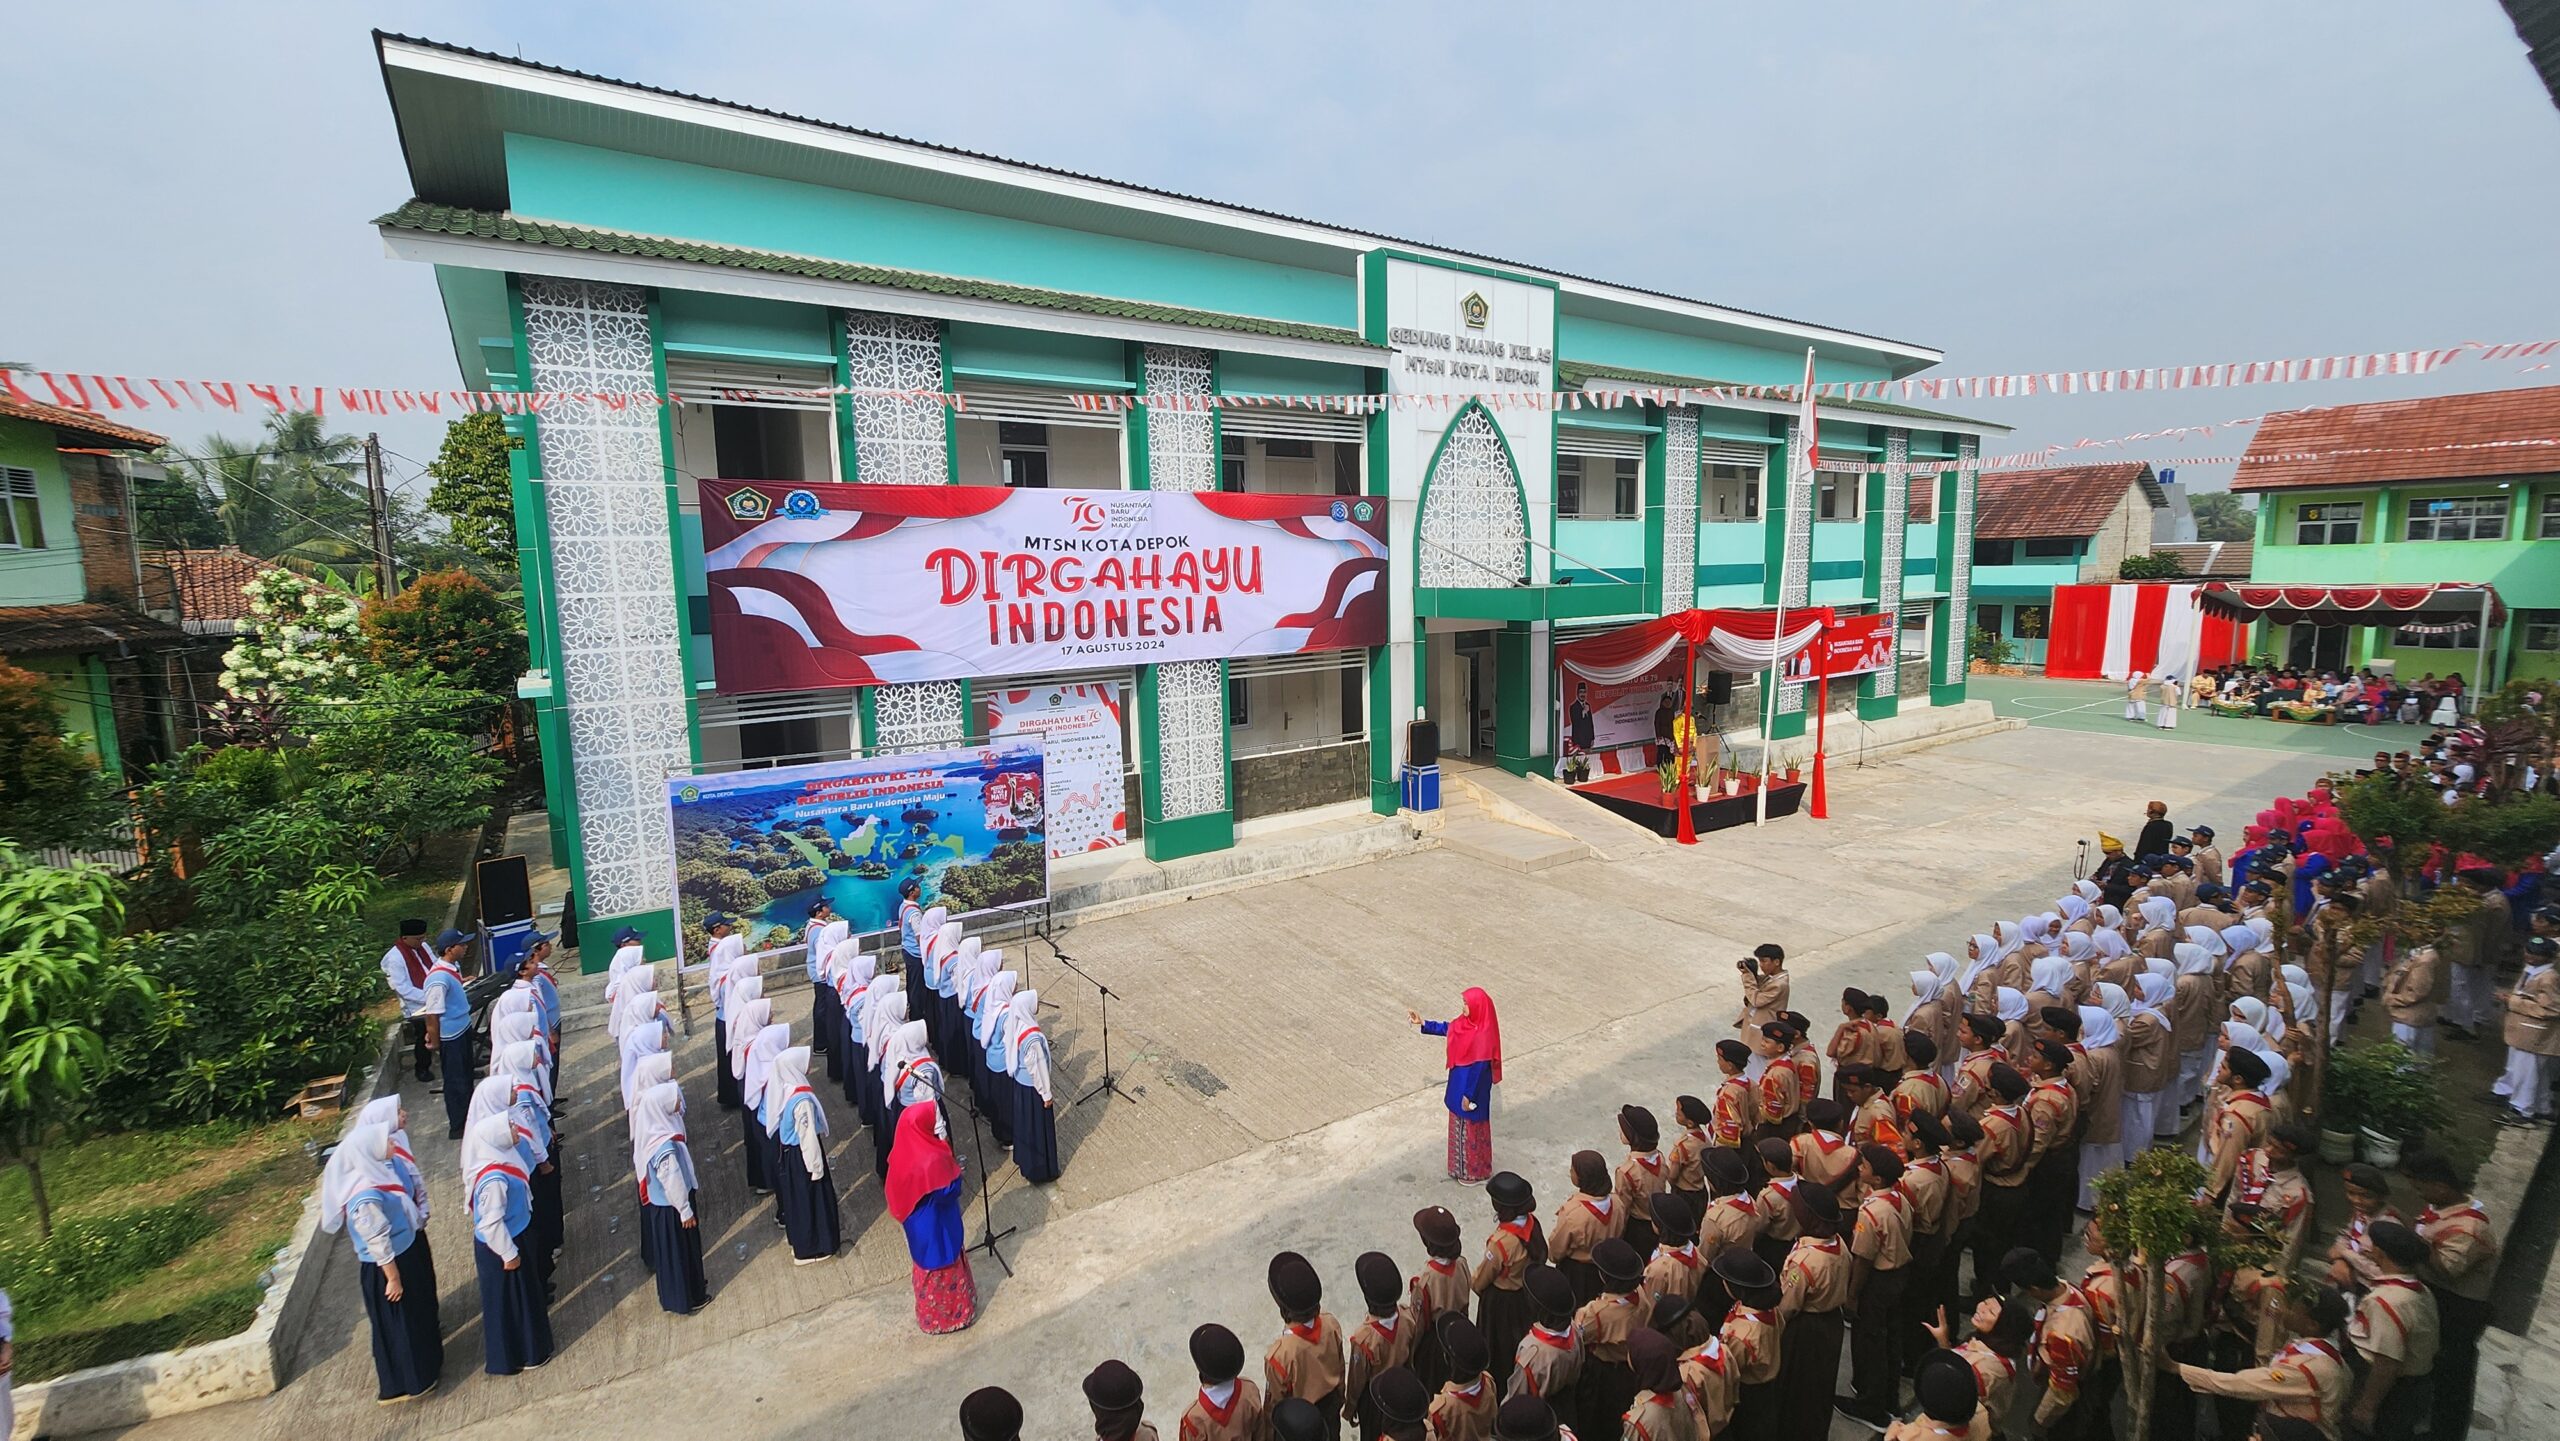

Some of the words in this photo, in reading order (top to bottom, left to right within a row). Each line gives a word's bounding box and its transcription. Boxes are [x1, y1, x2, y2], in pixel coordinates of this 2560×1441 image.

[1389, 327, 1452, 350] GEDUNG
[1455, 336, 1505, 357] RUANG
[1509, 344, 1552, 364] KELAS
[1405, 355, 1445, 375] MTsN
[1450, 360, 1489, 380] KOTA
[1494, 367, 1539, 386] DEPOK
[1024, 536, 1077, 552] MTSN
[1081, 538, 1132, 552] KOTA
[1136, 535, 1190, 551] DEPOK
[924, 545, 1264, 607] DIRGAHAYU
[988, 595, 1224, 646] INDONESIA
[1061, 646, 1073, 656] 17
[1076, 642, 1133, 655] AGUSTUS
[1135, 639, 1166, 651] 2024
[1019, 716, 1072, 728] DIRGAHAYU
[1055, 722, 1093, 731] INDONESIA
[796, 789, 869, 806] REPUBLIK
[872, 780, 945, 796] INDONESIA
[806, 774, 886, 791] DIRGAHAYU
[889, 771, 907, 782] KE
[918, 769, 933, 778] 79
[795, 805, 849, 819] Nusantara
[850, 802, 874, 812] Baru
[875, 797, 922, 808] Indonesia
[923, 793, 946, 802] Maju
